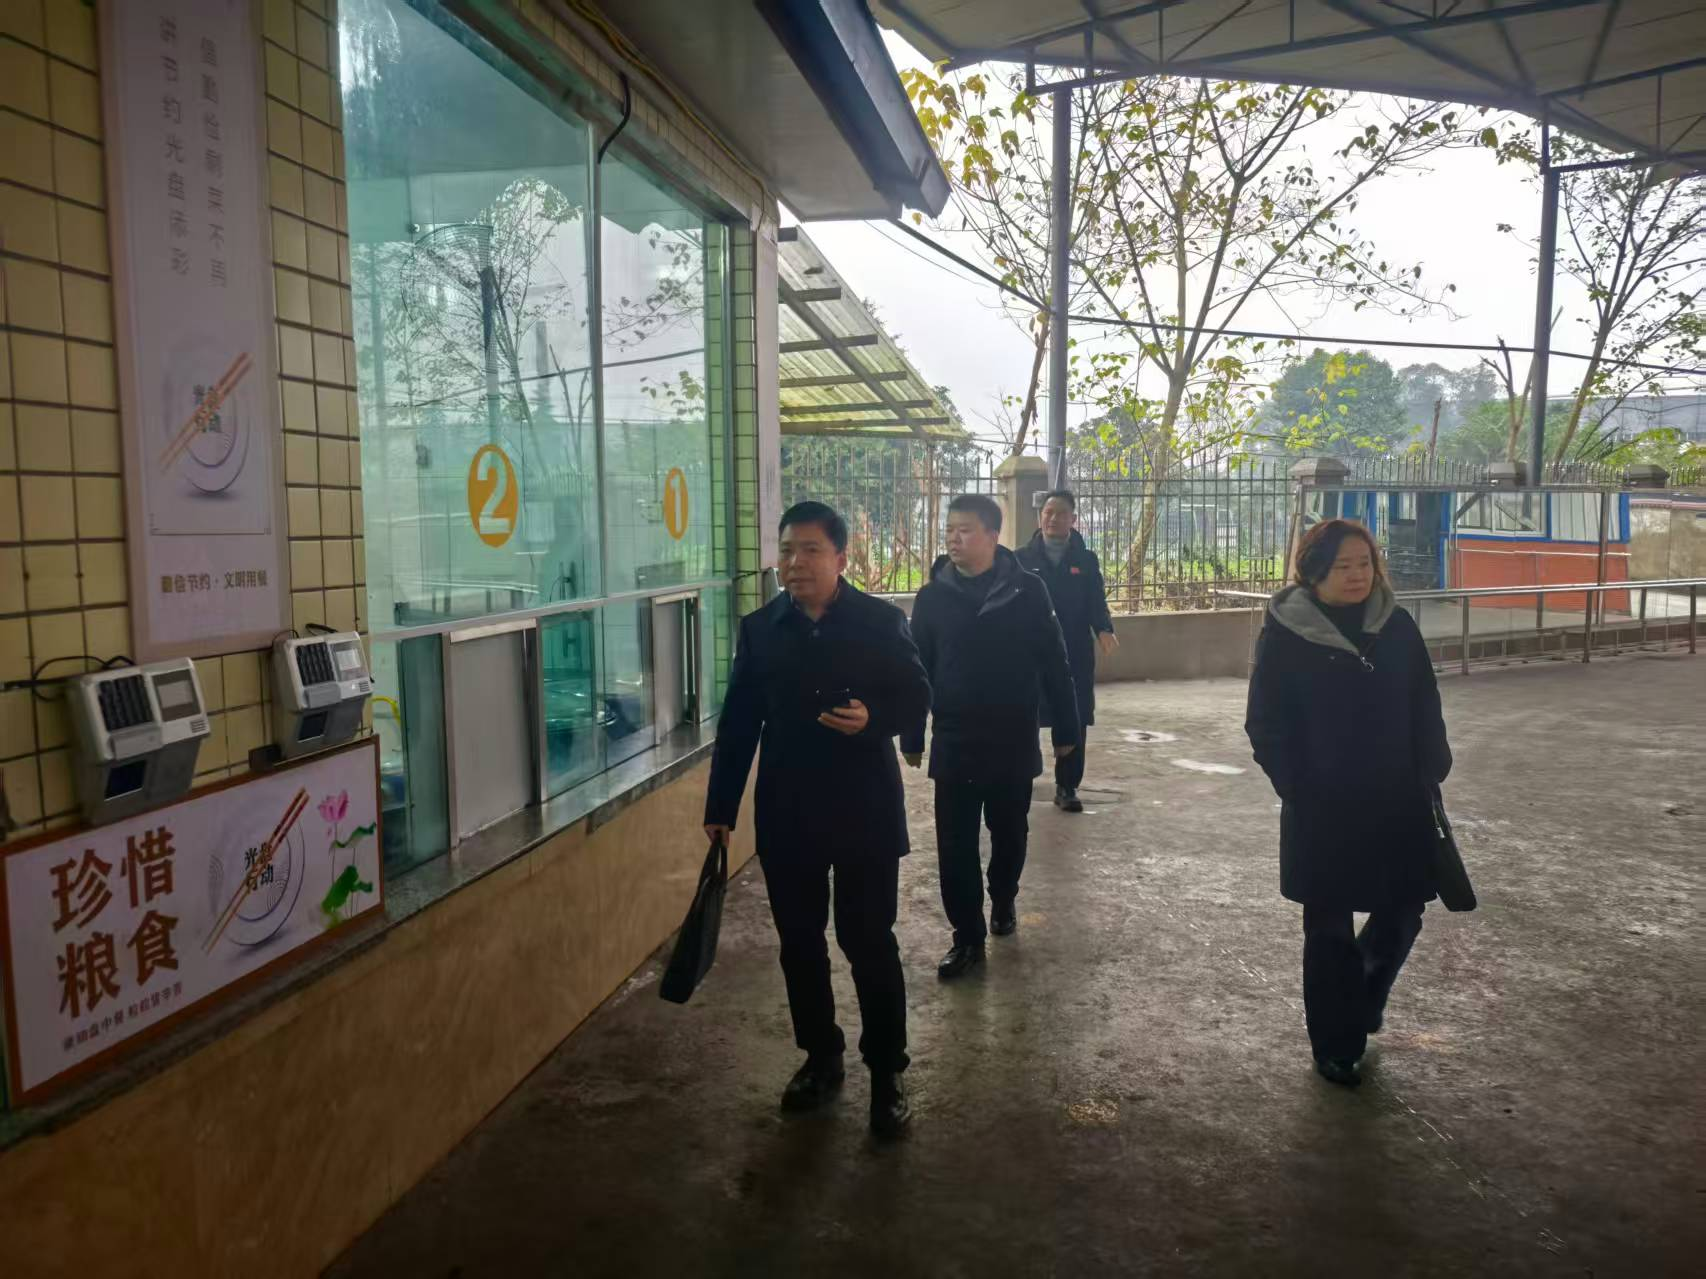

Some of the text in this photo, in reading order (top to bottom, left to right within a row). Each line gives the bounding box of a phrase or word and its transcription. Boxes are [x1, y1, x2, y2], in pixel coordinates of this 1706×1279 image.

[476, 450, 511, 535] 2
[670, 473, 683, 533] 1
[49, 824, 177, 934] 珍惜
[56, 909, 181, 1019] 粮食
